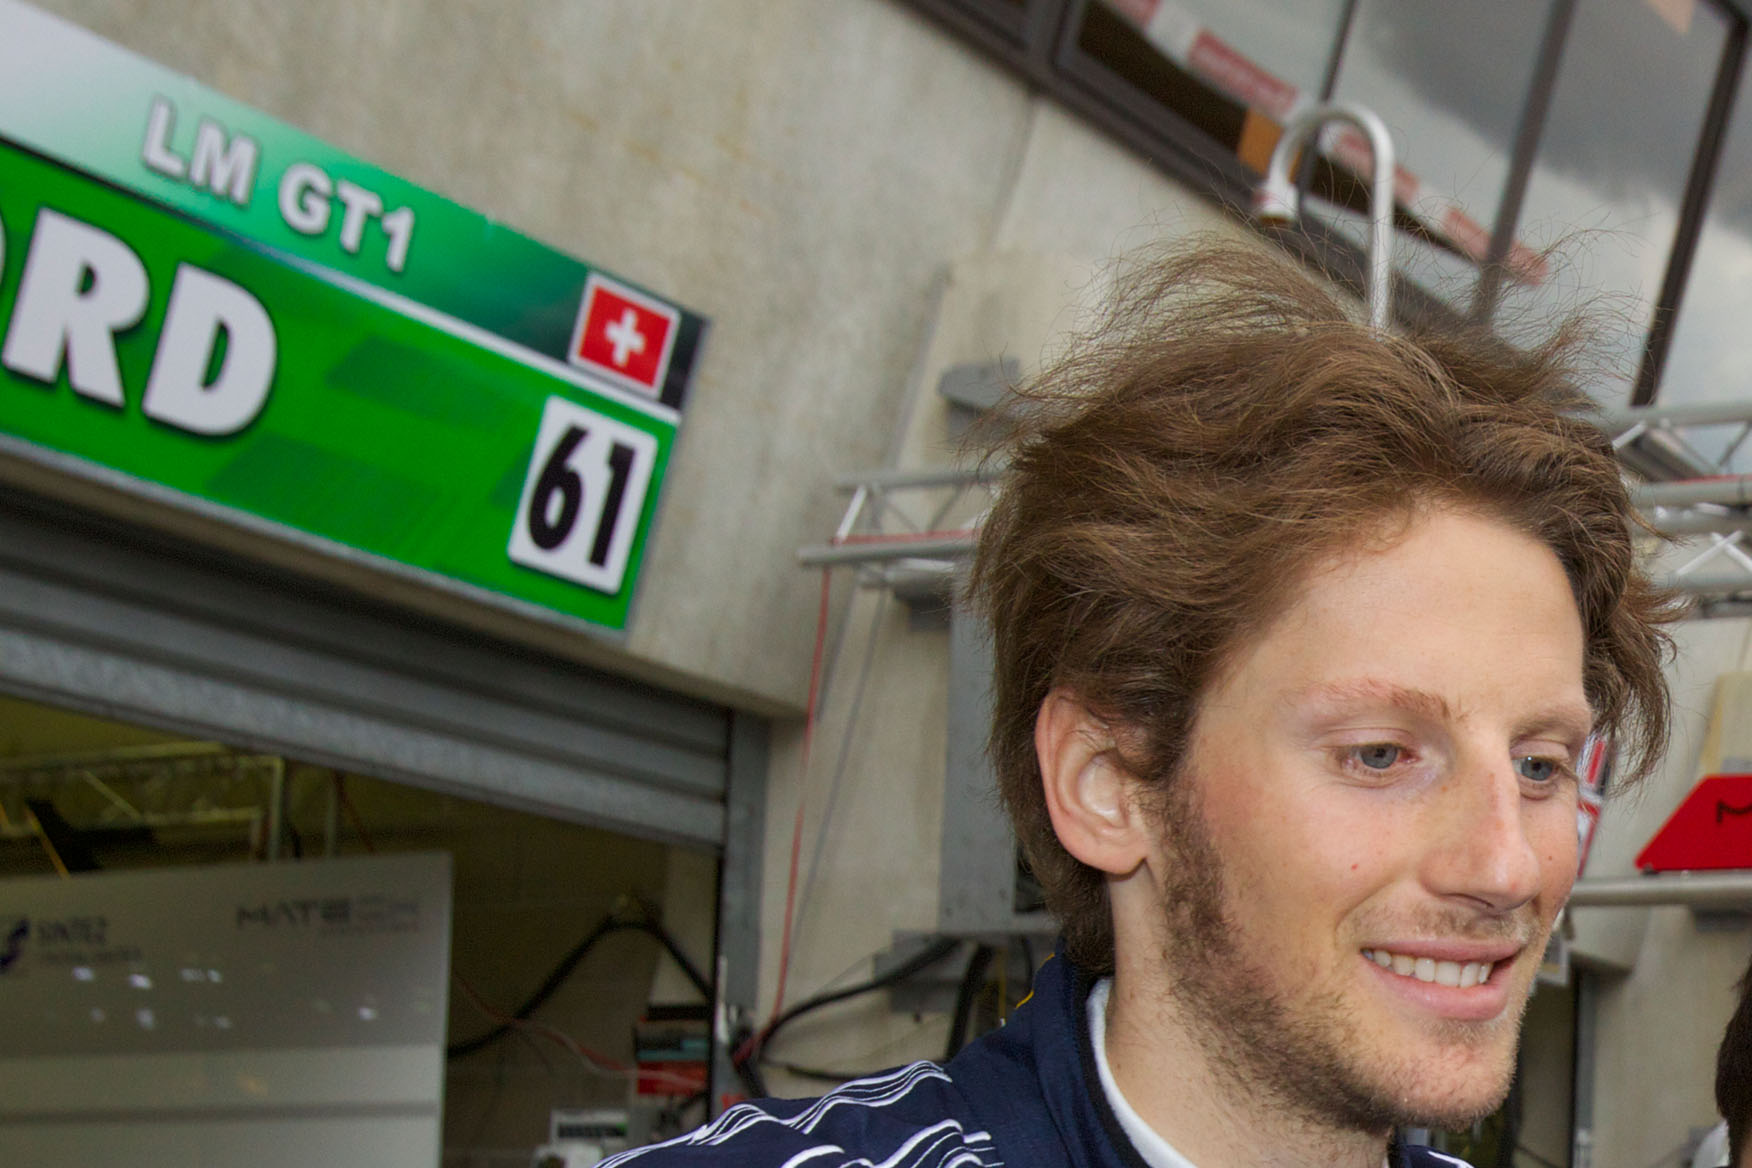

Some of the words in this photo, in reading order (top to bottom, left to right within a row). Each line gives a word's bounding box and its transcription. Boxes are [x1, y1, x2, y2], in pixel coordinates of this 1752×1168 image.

[141, 97, 258, 206] LM
[278, 163, 415, 272] GT1
[0, 205, 278, 438] RD
[527, 424, 637, 569] 61
